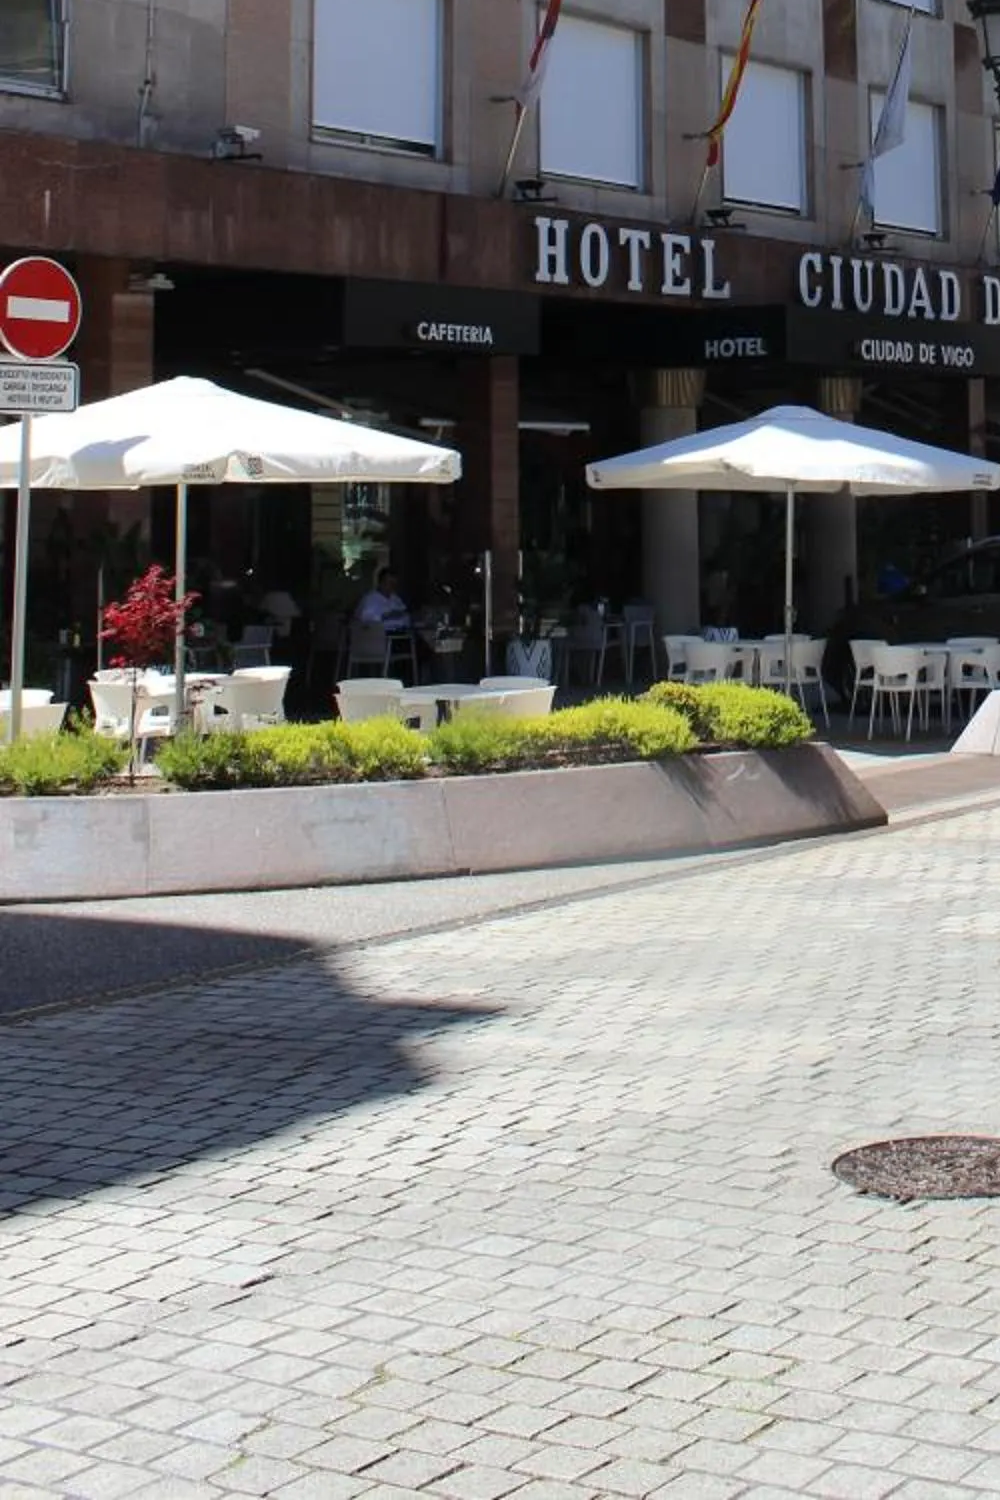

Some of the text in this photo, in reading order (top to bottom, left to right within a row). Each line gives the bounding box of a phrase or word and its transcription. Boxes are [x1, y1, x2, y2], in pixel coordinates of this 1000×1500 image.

[535, 216, 731, 299] HOTEL
[799, 252, 961, 322] CIUDAD
[417, 322, 494, 344] CAFETERIA
[704, 337, 975, 367] HOTEL CIUDAD DE VIGO
